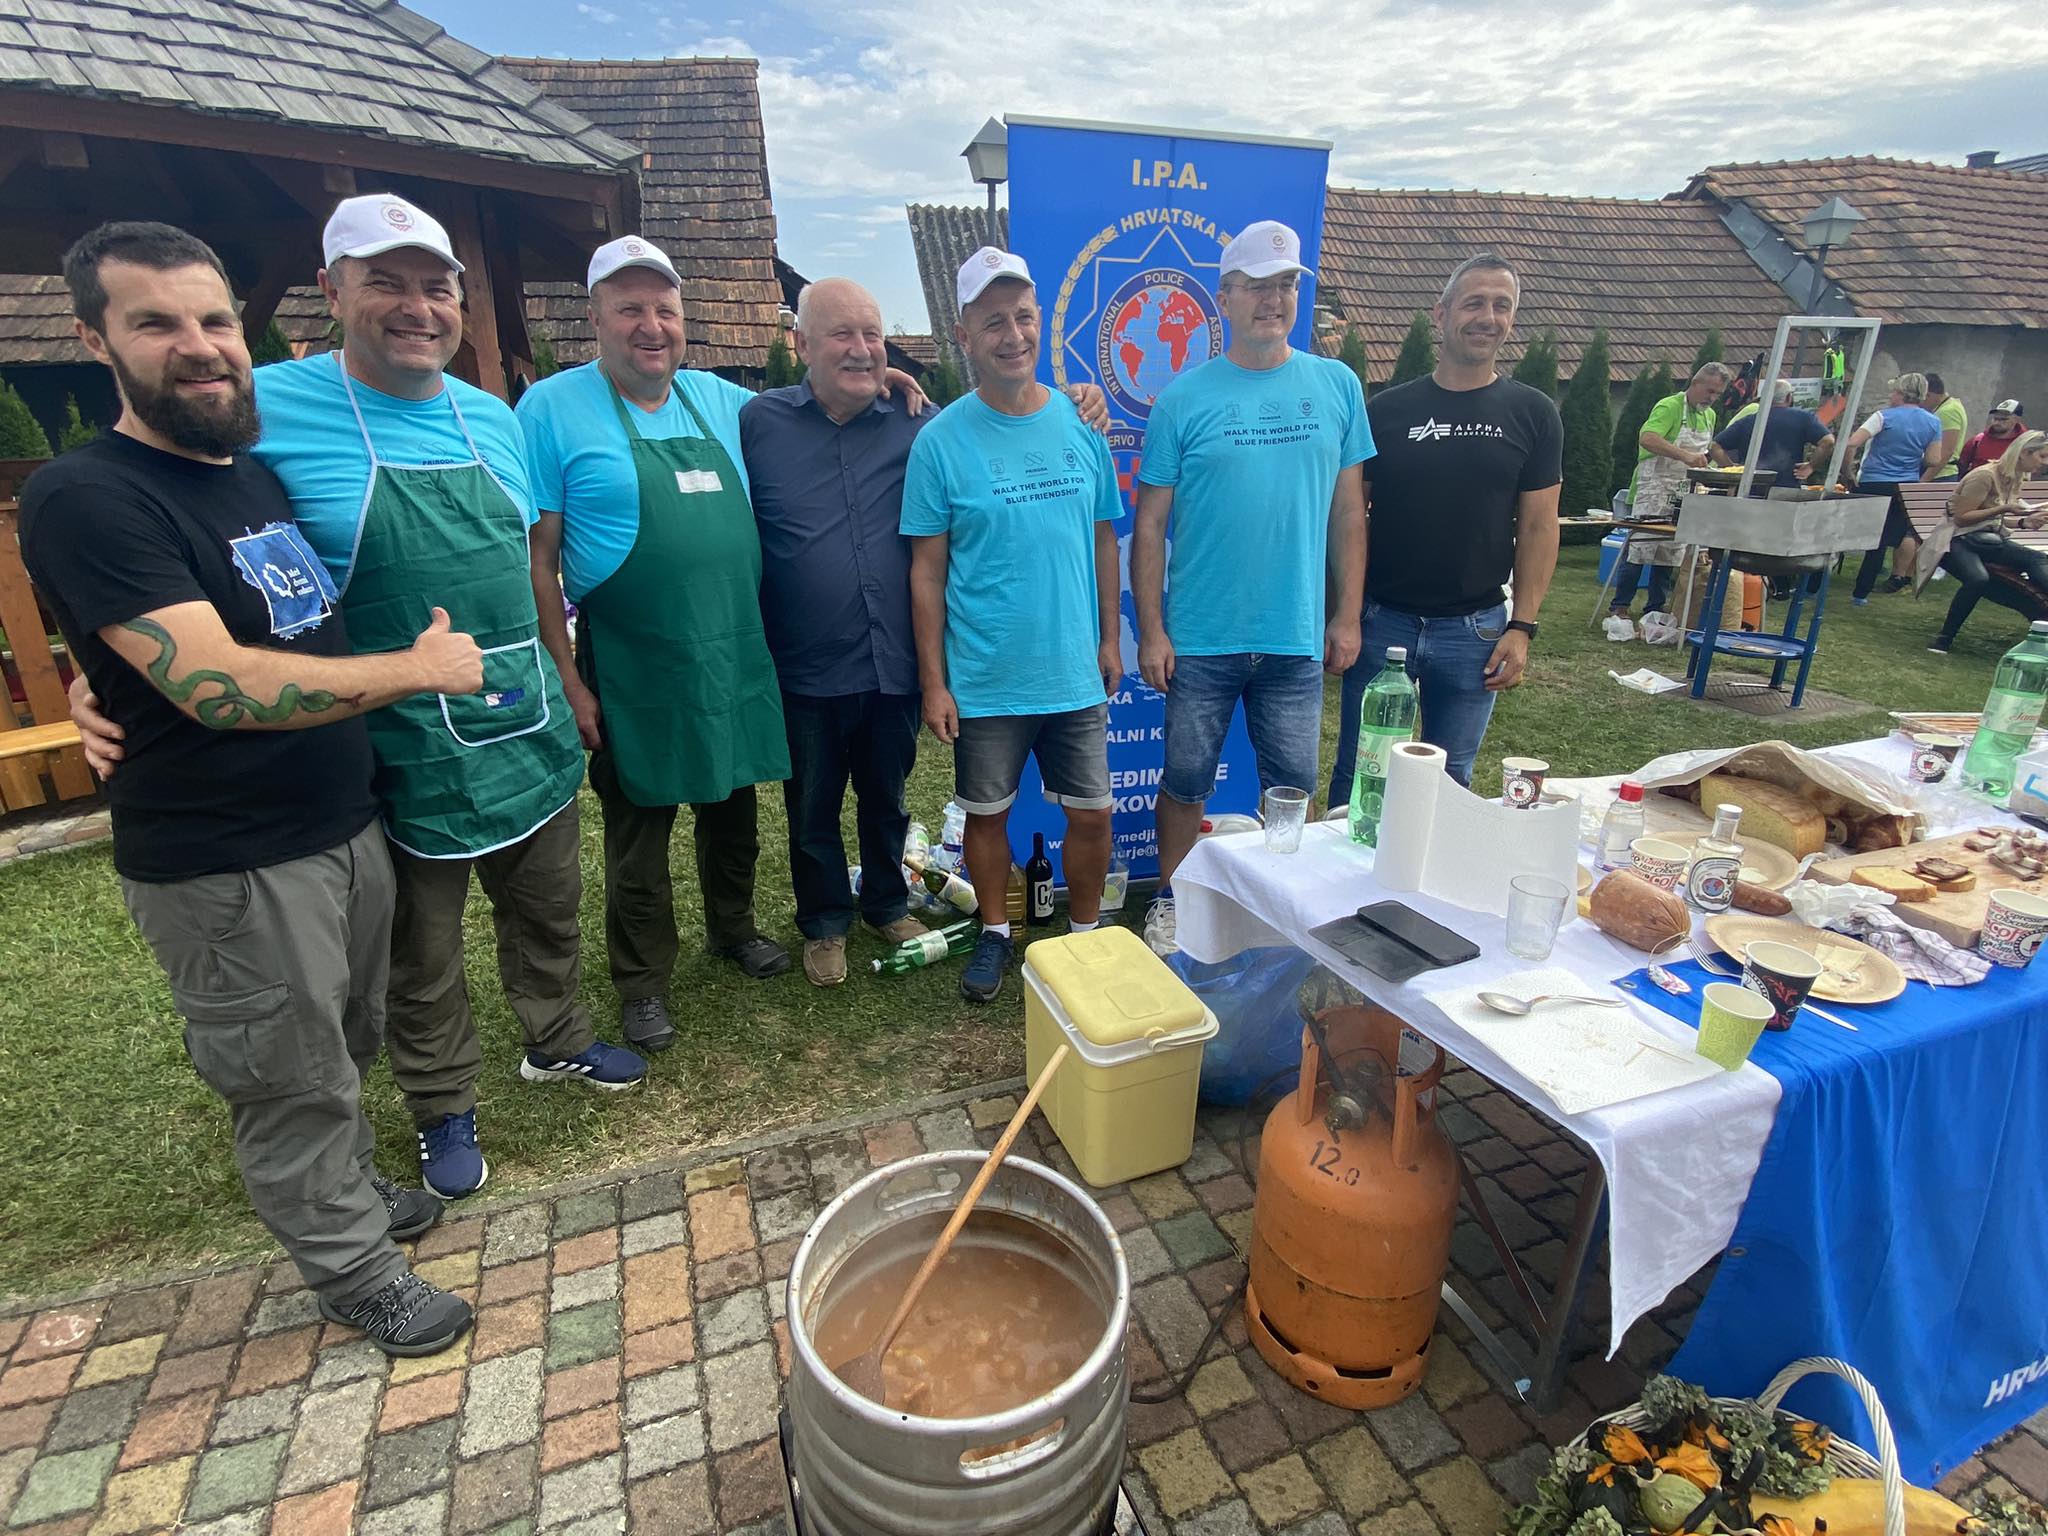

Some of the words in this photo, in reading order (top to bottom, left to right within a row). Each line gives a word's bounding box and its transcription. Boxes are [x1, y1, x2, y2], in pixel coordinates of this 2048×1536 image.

[1132, 159, 1208, 190] I.P.A.
[1120, 207, 1216, 239] HRVATSKA
[1144, 272, 1185, 287] POLICE
[1100, 299, 1124, 396] INTERNATIONAL
[1223, 429, 1248, 437] WALK
[1251, 428, 1267, 436] THE
[1269, 424, 1301, 435] WORLD
[1302, 423, 1320, 431] FOR
[1455, 423, 1503, 433] ALPHA
[1234, 438, 1257, 446] BLUE
[1258, 434, 1311, 446] FRIENDSHIP
[992, 485, 1018, 496] WALK
[1020, 481, 1037, 492] THE
[1038, 477, 1069, 489] WORLD
[1071, 476, 1085, 485] FOR
[1005, 494, 1028, 505] BLUE
[1029, 487, 1080, 502] FRIENDSHIP
